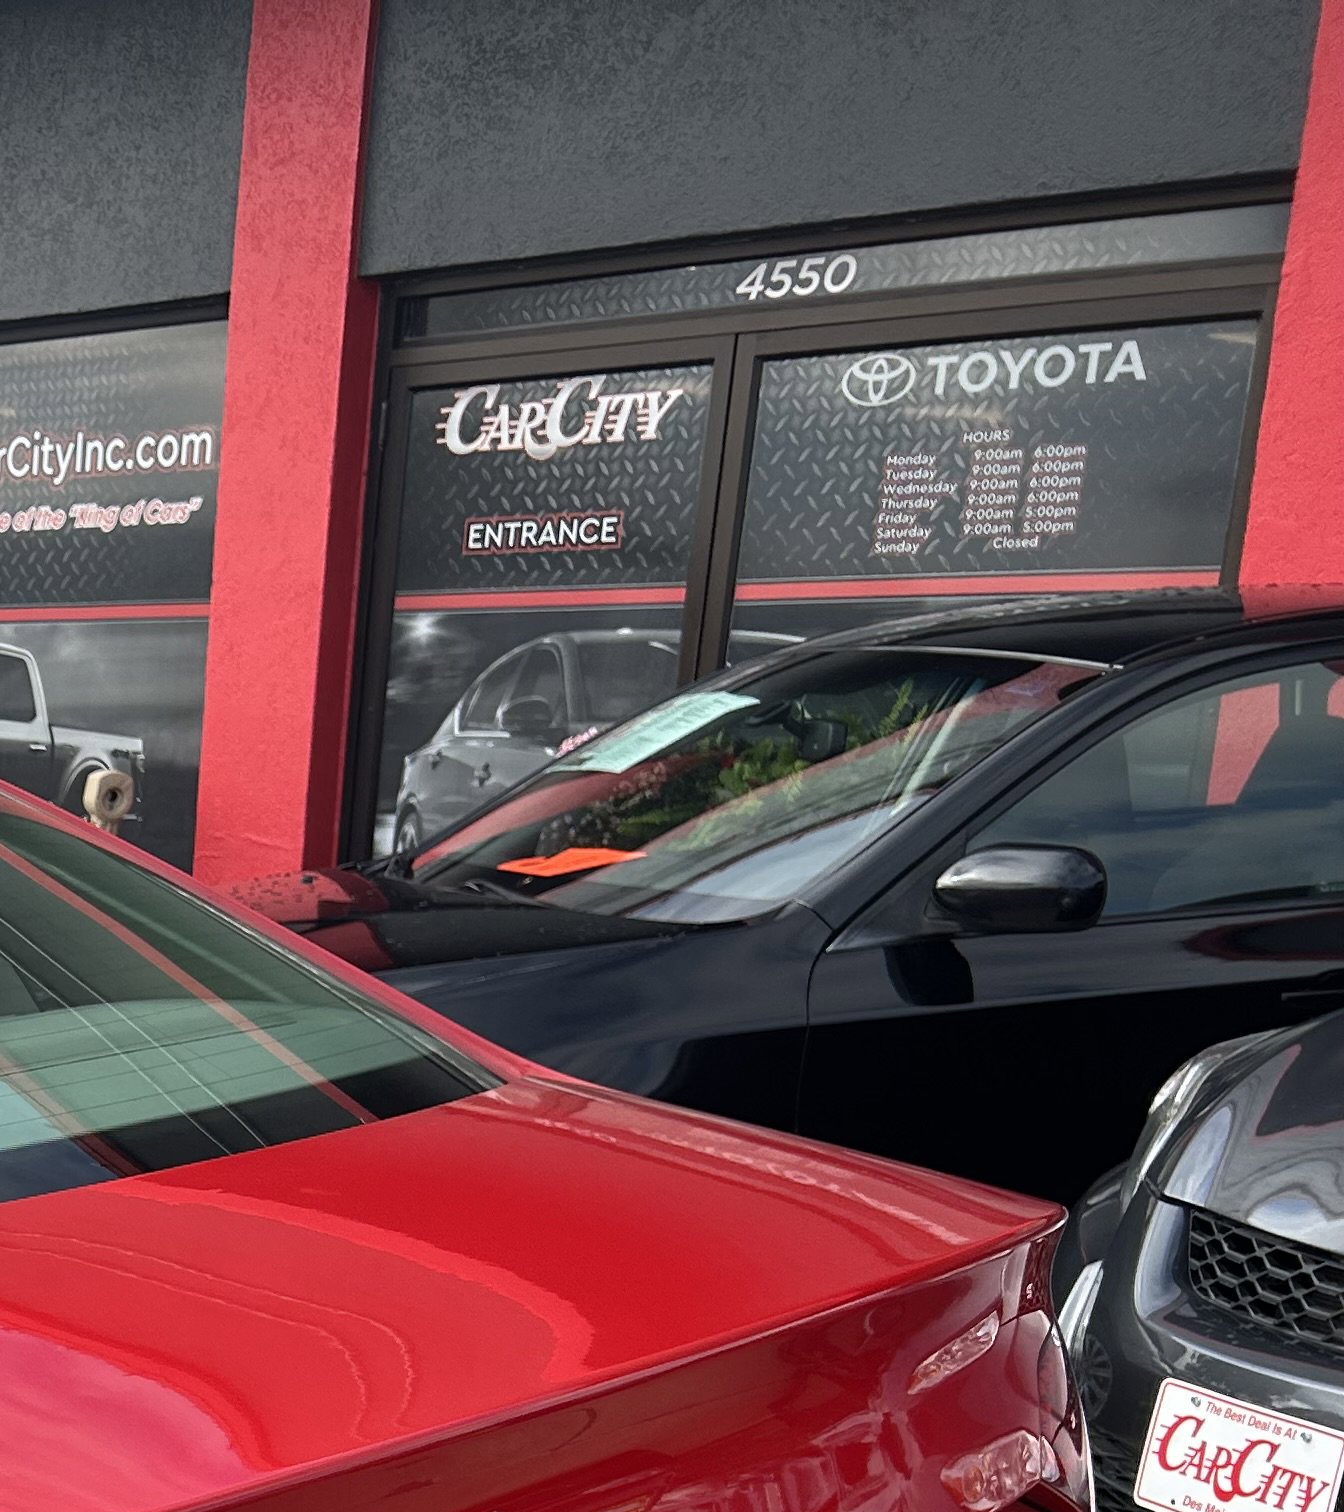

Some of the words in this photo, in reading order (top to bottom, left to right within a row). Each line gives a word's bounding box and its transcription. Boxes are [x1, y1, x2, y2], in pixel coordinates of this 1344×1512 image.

[736, 254, 858, 301] 4550
[927, 340, 1148, 397] TOYOTA
[963, 429, 1010, 442] HOURS
[886, 453, 936, 467] Monday
[974, 448, 1023, 460] 9:00am
[1034, 445, 1087, 458] 6:00pm
[885, 468, 937, 481] Tuesday
[972, 463, 1021, 475] 9:00am
[1032, 460, 1084, 473] 6:00pm
[883, 481, 958, 495] Wednesday
[969, 478, 1018, 490] 9:00am
[1029, 475, 1081, 488] 6:00pm
[881, 497, 938, 510] Thursday
[967, 493, 1016, 505] 9:00am
[1027, 490, 1079, 503] 6:00pm
[878, 512, 917, 525] Friday
[965, 508, 1014, 520] 9:00am
[1025, 506, 1076, 519] 5:00pm
[468, 516, 619, 549] ENTRANCE
[876, 526, 933, 540] Saturday
[963, 523, 1012, 535] 9:00am
[1023, 521, 1074, 533] 5:00pm
[874, 541, 920, 554] Sunday
[992, 535, 1039, 549] Closed
[1206, 1401, 1223, 1417] The
[1224, 1407, 1246, 1425] Best
[1248, 1415, 1272, 1432] Deal
[1182, 1494, 1203, 1512] Des
